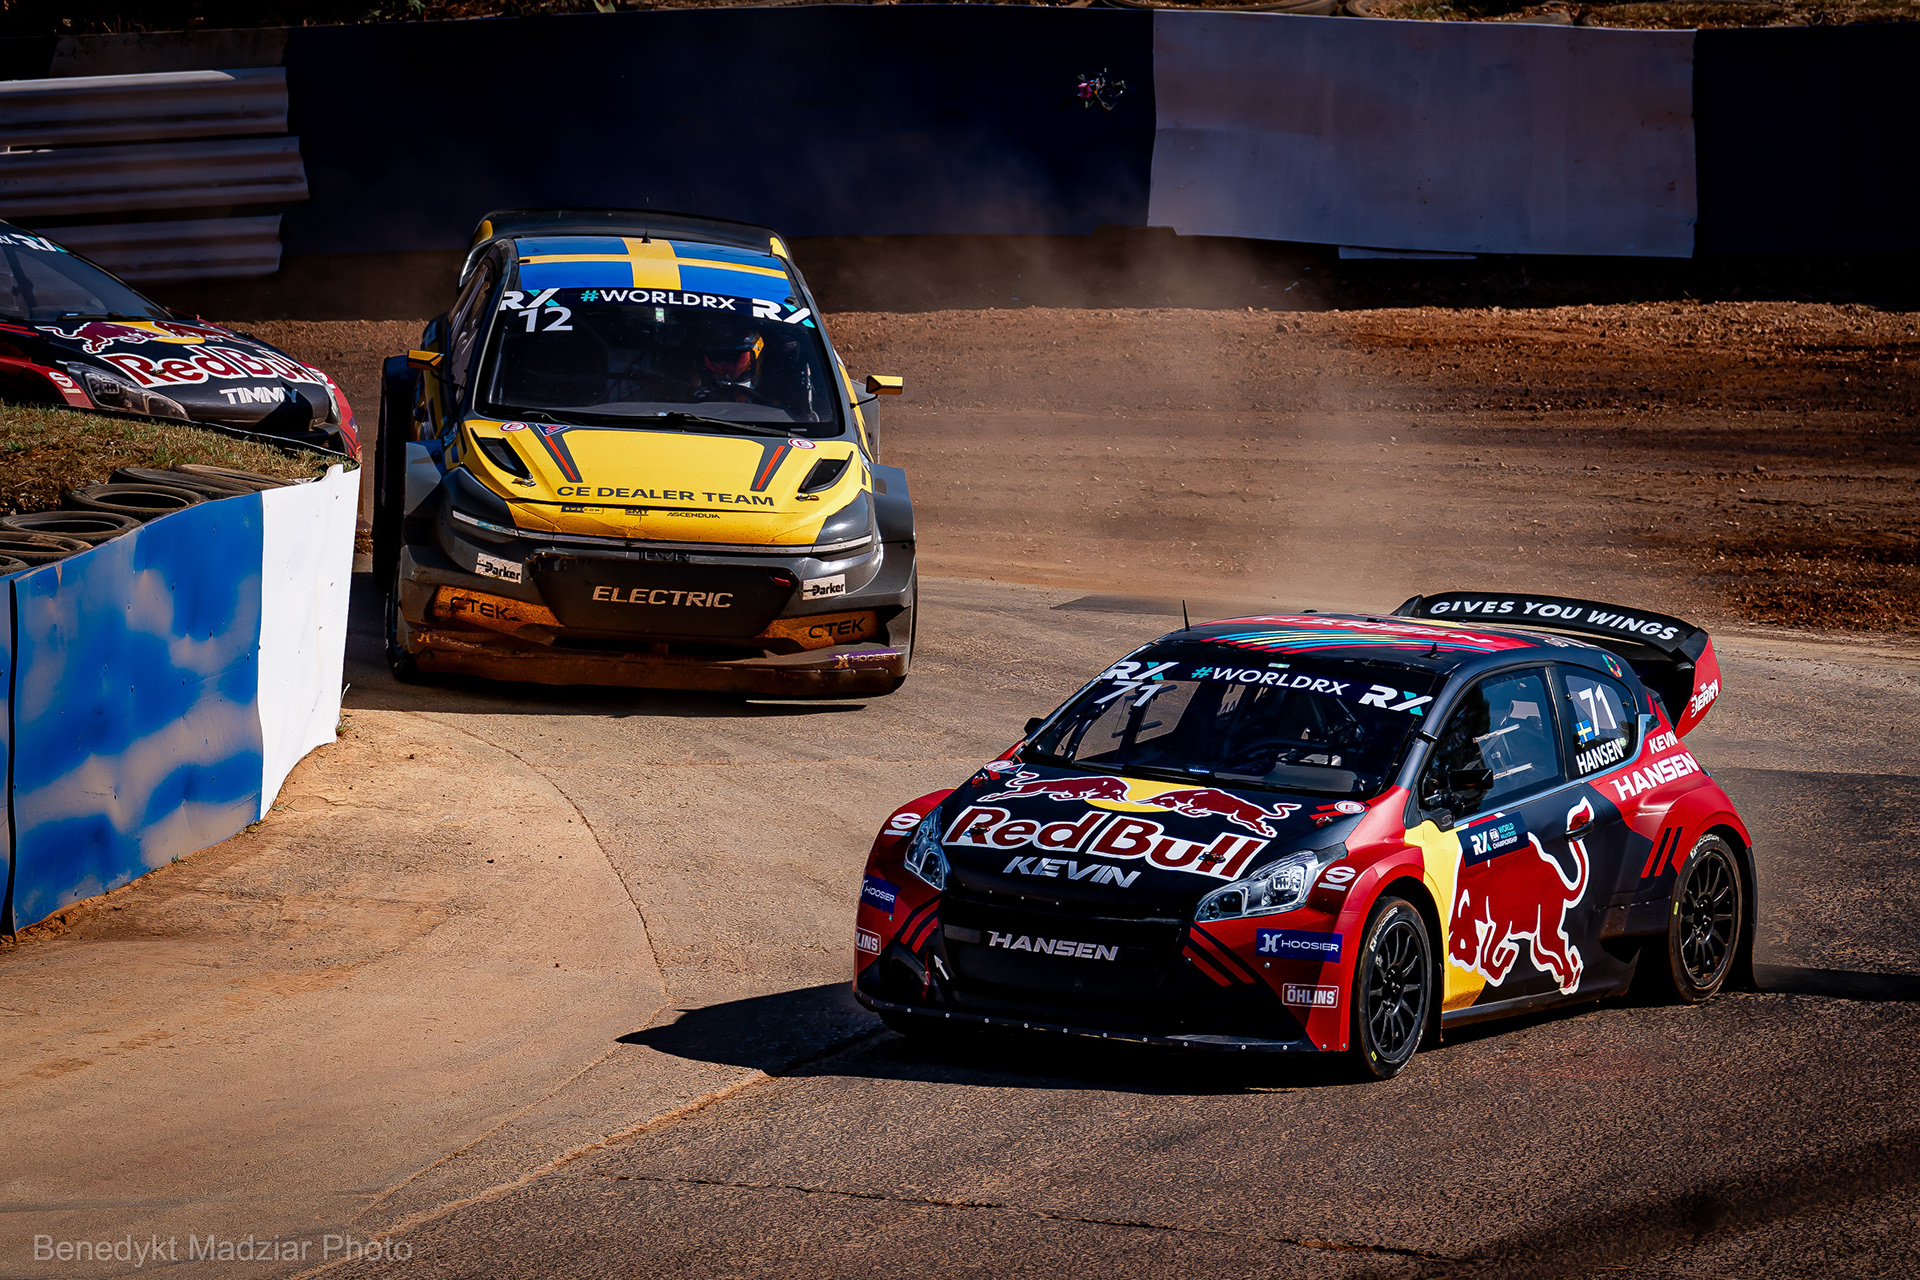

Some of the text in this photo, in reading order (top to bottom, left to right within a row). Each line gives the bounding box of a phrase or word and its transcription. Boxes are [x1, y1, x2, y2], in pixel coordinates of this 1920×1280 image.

[499, 288, 561, 311] RX
[580, 289, 736, 311] #WORLDRX
[518, 306, 573, 332] 12
[752, 298, 815, 328] RX
[97, 345, 247, 388] Red
[218, 384, 298, 405] TIMMY
[557, 486, 775, 507] CE DEALER TEAM
[667, 511, 721, 519] ASCENDUM
[485, 561, 521, 581] Parker
[592, 585, 734, 609] ELECTRIC
[812, 583, 845, 596] Parker
[450, 597, 511, 620] CTEK
[1430, 600, 1515, 615] GIVES
[1522, 602, 1583, 619] YOU
[1586, 609, 1679, 641] WINGS
[808, 617, 866, 639] CTEK
[1101, 661, 1180, 681] RX
[1191, 666, 1351, 696] #WORLDRX
[1093, 681, 1163, 707] 71
[1358, 684, 1434, 716] RX
[1578, 684, 1618, 737] 71
[1576, 738, 1624, 775] HANSEN
[1609, 751, 1700, 802] HANSEN
[941, 805, 1271, 882] Red Bull
[1002, 856, 1142, 888] KEVIN
[863, 886, 896, 903] HOOSIER
[987, 930, 1120, 961] HANSEN
[1281, 940, 1339, 953] HOOSIER
[1287, 985, 1336, 1005] ÖHLINS
